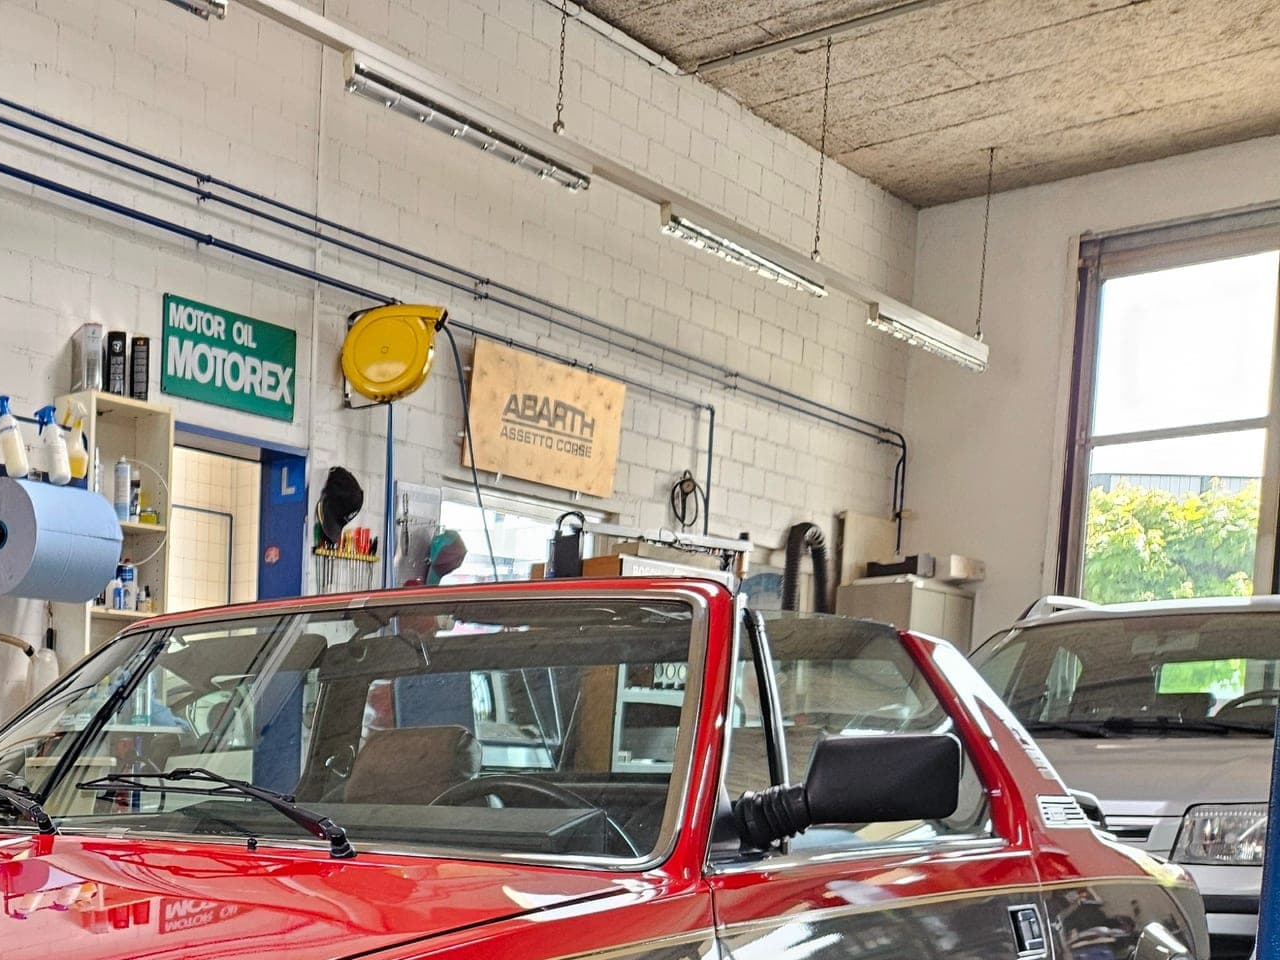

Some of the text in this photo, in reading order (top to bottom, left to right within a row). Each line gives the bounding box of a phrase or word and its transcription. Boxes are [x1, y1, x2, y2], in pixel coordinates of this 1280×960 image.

[169, 302, 257, 349] MOTOR OIL
[167, 336, 293, 405] MOTOREX
[502, 393, 595, 437] ABARTH
[500, 425, 593, 458] ASSETTO CORSE
[281, 466, 296, 496] L
